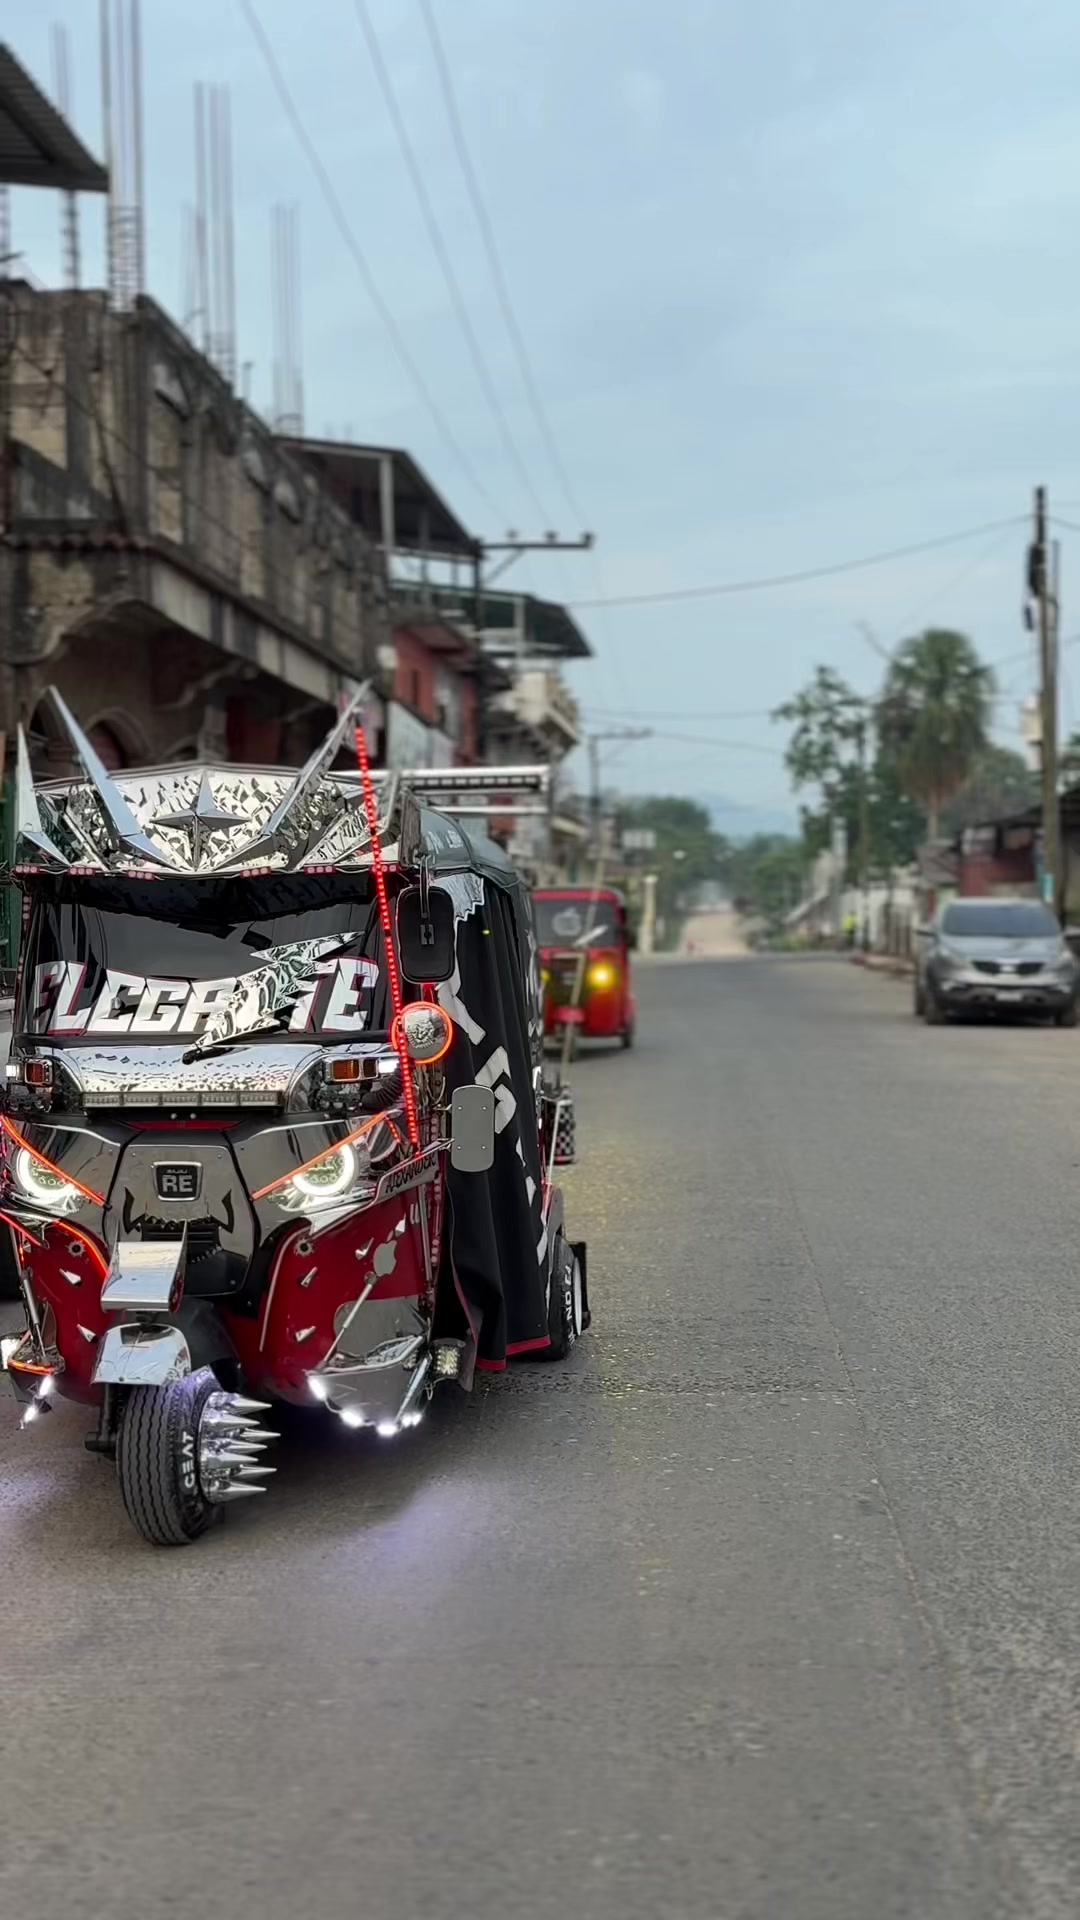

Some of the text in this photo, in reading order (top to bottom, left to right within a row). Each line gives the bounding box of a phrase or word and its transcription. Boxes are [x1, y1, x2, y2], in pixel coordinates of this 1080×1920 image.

[33, 957, 379, 1035] ELEGATE
[162, 1174, 193, 1192] RE
[182, 1431, 195, 1489] CEAT
